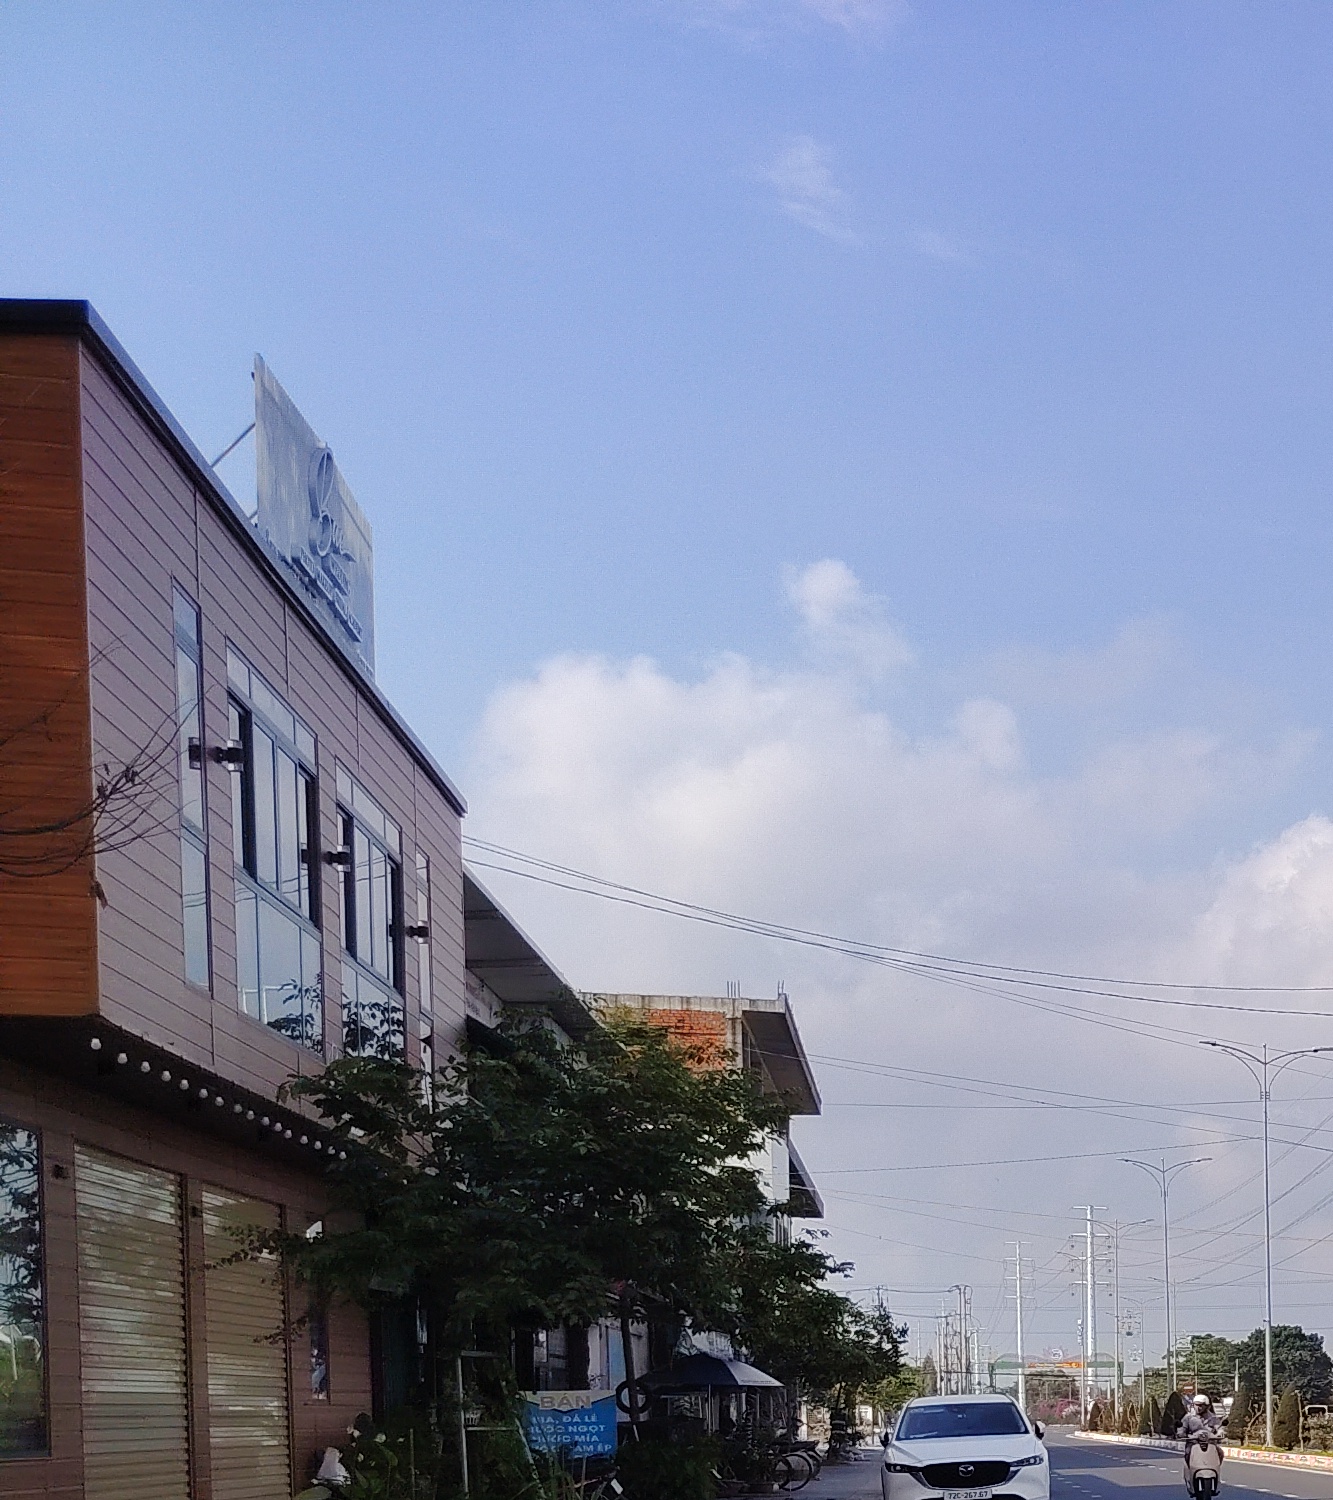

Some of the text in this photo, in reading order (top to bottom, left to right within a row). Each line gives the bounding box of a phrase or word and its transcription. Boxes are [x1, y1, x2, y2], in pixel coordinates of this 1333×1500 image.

[540, 1393, 591, 1409] BÁN
[568, 1424, 606, 1434] NGỌT
[570, 1444, 594, 1453] AM
